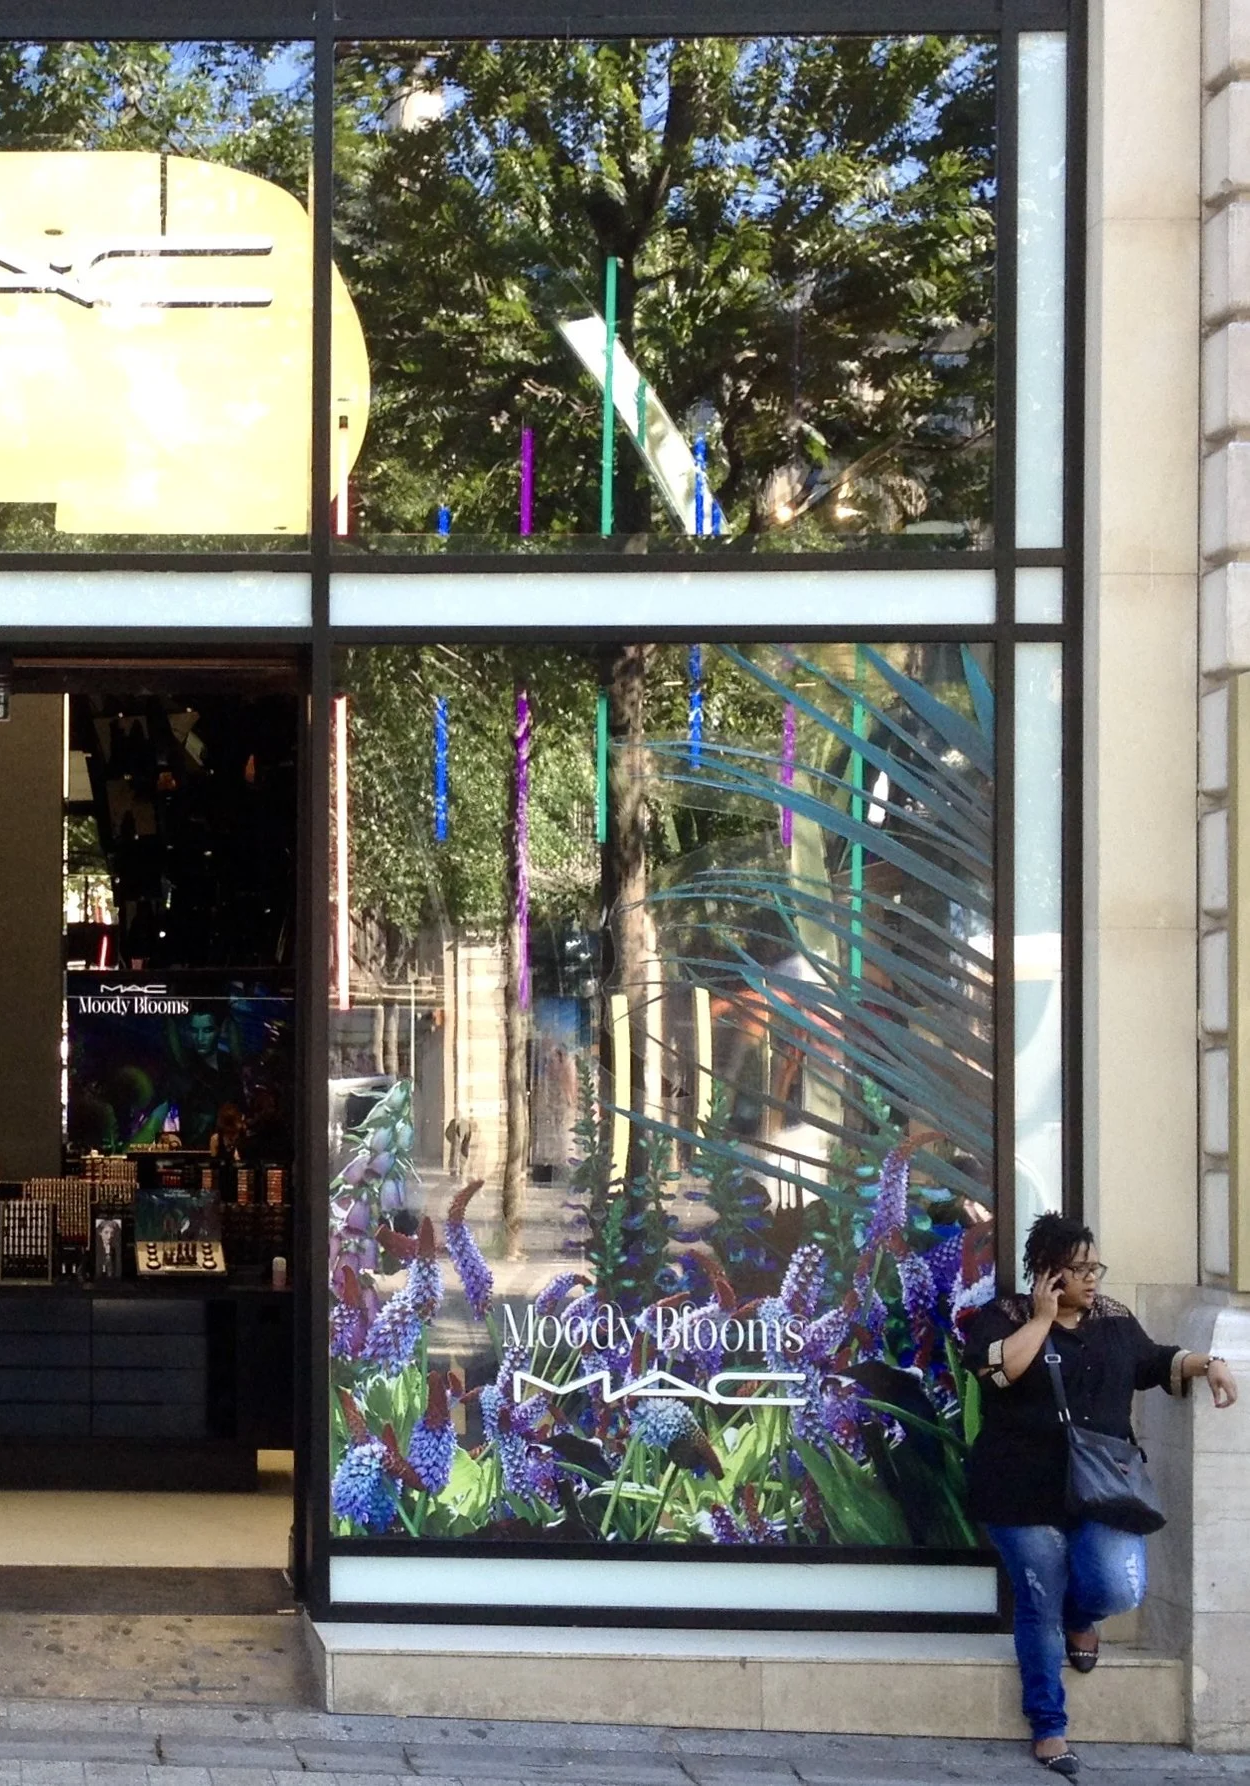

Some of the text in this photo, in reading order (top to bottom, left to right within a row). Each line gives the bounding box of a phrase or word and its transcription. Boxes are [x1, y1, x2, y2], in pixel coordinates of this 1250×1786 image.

[100, 984, 167, 994] MAC
[78, 995, 190, 1016] Moody Blooms
[501, 1301, 808, 1358] Moody Blooms
[513, 1370, 807, 1405] MAC
